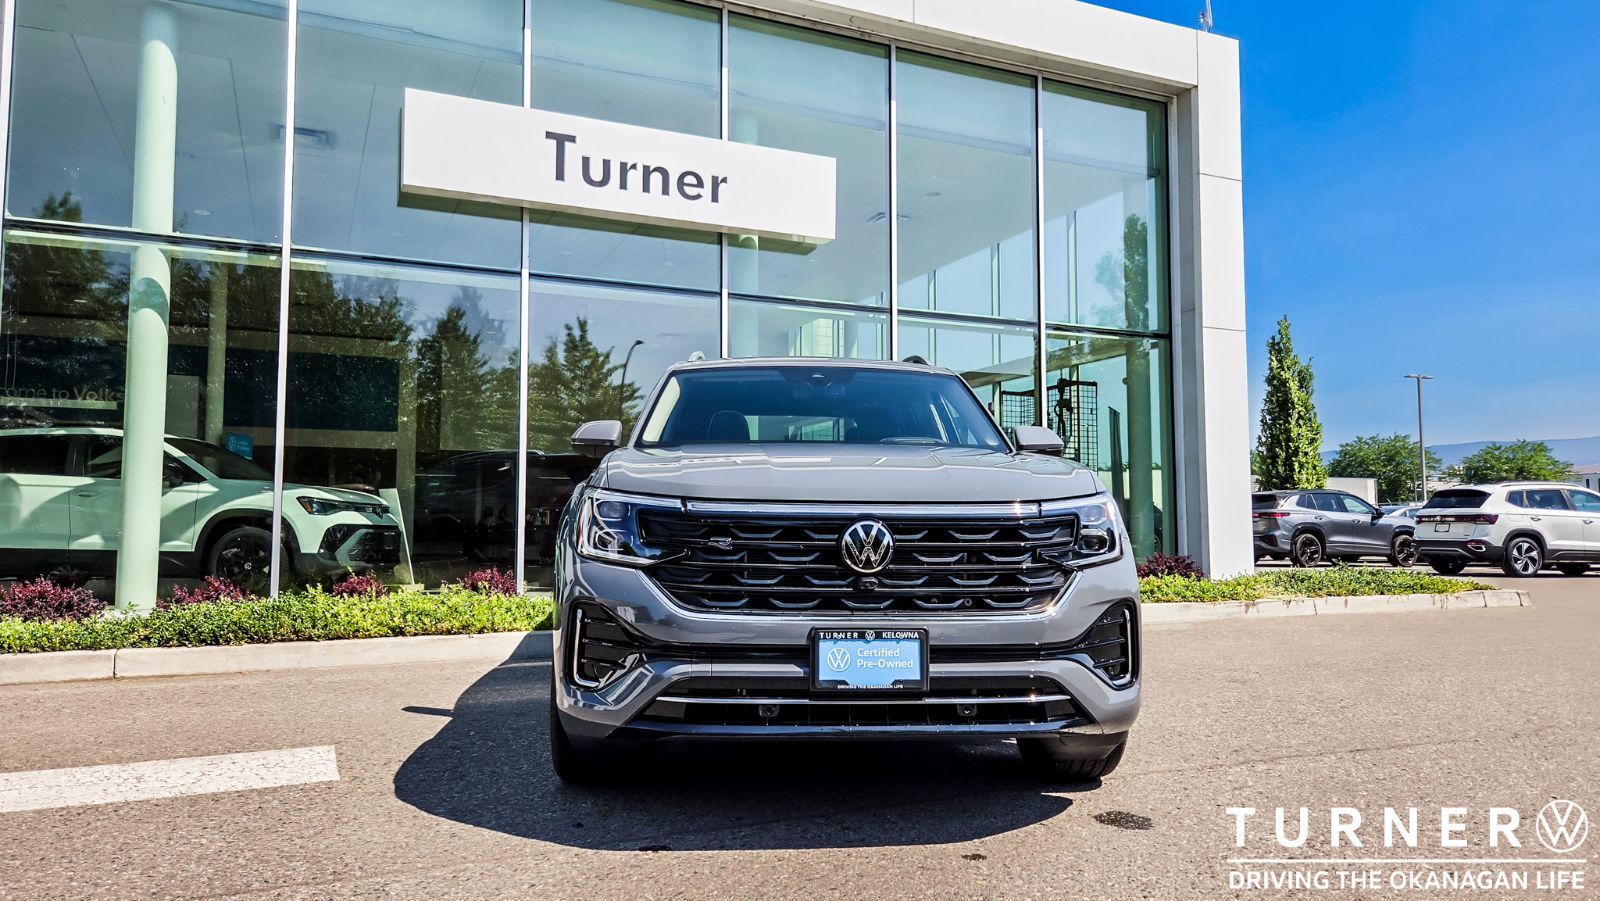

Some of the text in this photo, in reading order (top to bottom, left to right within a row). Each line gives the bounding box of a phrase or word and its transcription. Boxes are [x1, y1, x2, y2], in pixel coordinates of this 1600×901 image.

[545, 131, 728, 203] Turner
[52, 387, 70, 400] to
[882, 631, 919, 639] KELOWNA
[857, 648, 900, 657] Certified
[857, 659, 914, 668] Pre-Owned
